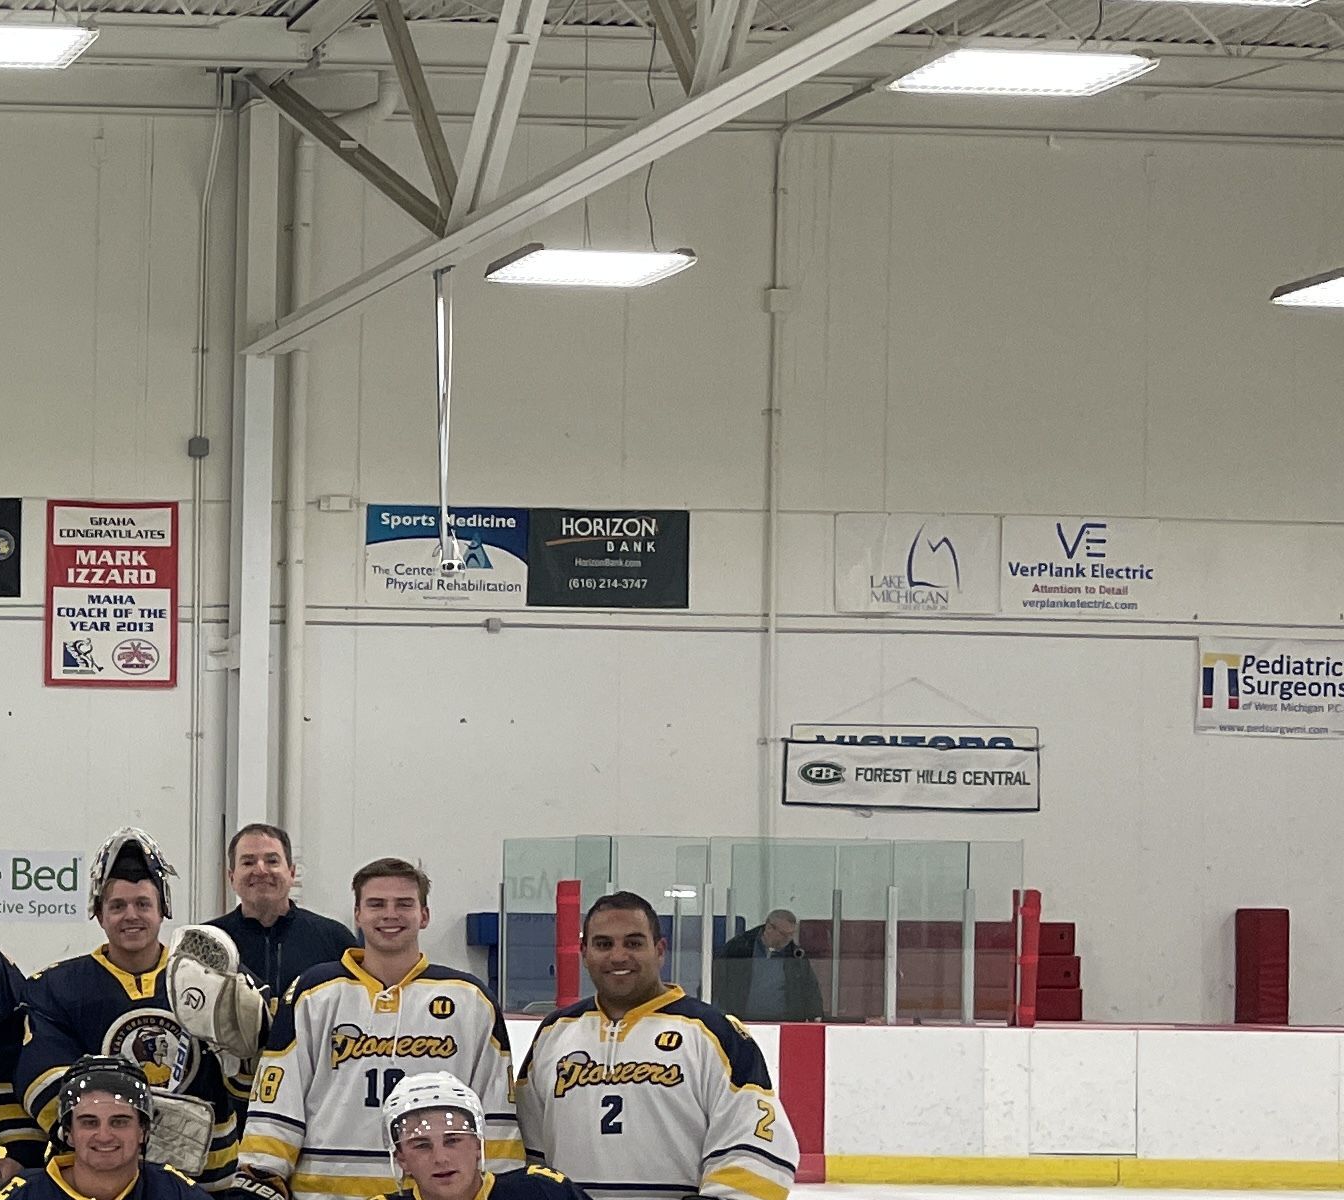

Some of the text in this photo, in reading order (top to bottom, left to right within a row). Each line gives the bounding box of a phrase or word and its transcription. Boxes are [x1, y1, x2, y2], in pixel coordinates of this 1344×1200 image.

[89, 516, 136, 527] GRAHA
[380, 512, 436, 529] Sports
[562, 517, 657, 537] HORIZON
[59, 528, 166, 540] CONGRATULATES
[606, 541, 656, 552] BANK
[75, 549, 149, 566] MARK
[575, 558, 642, 567] HorizonBank.com
[67, 567, 157, 585] IZZARD
[372, 563, 436, 576] The Cente
[1008, 561, 1154, 580] VerPlank Electric
[385, 577, 522, 593] Physical Rehabilitation
[568, 578, 648, 590] (616) 214-3747
[870, 575, 906, 589] LAKE
[1031, 583, 1129, 596] Attention to Detail
[87, 594, 136, 605] MAHA
[870, 589, 949, 605] MICHIGAN
[56, 607, 167, 619] COACH OF THE
[69, 621, 154, 632] YEAR 2013
[1241, 654, 1343, 677] Pediatric
[1242, 701, 1253, 711] of
[1255, 702, 1277, 711] West
[1280, 702, 1324, 714] Michigan
[855, 767, 1031, 786] FOREST HILLS CENTRAL
[12, 857, 78, 891] Bed
[28, 902, 77, 917] Sports
[431, 999, 452, 1016] KJ
[331, 1026, 458, 1069] Pioneers
[657, 1032, 681, 1049] KJ
[599, 1094, 623, 1135] 2
[753, 1099, 776, 1142] 2
